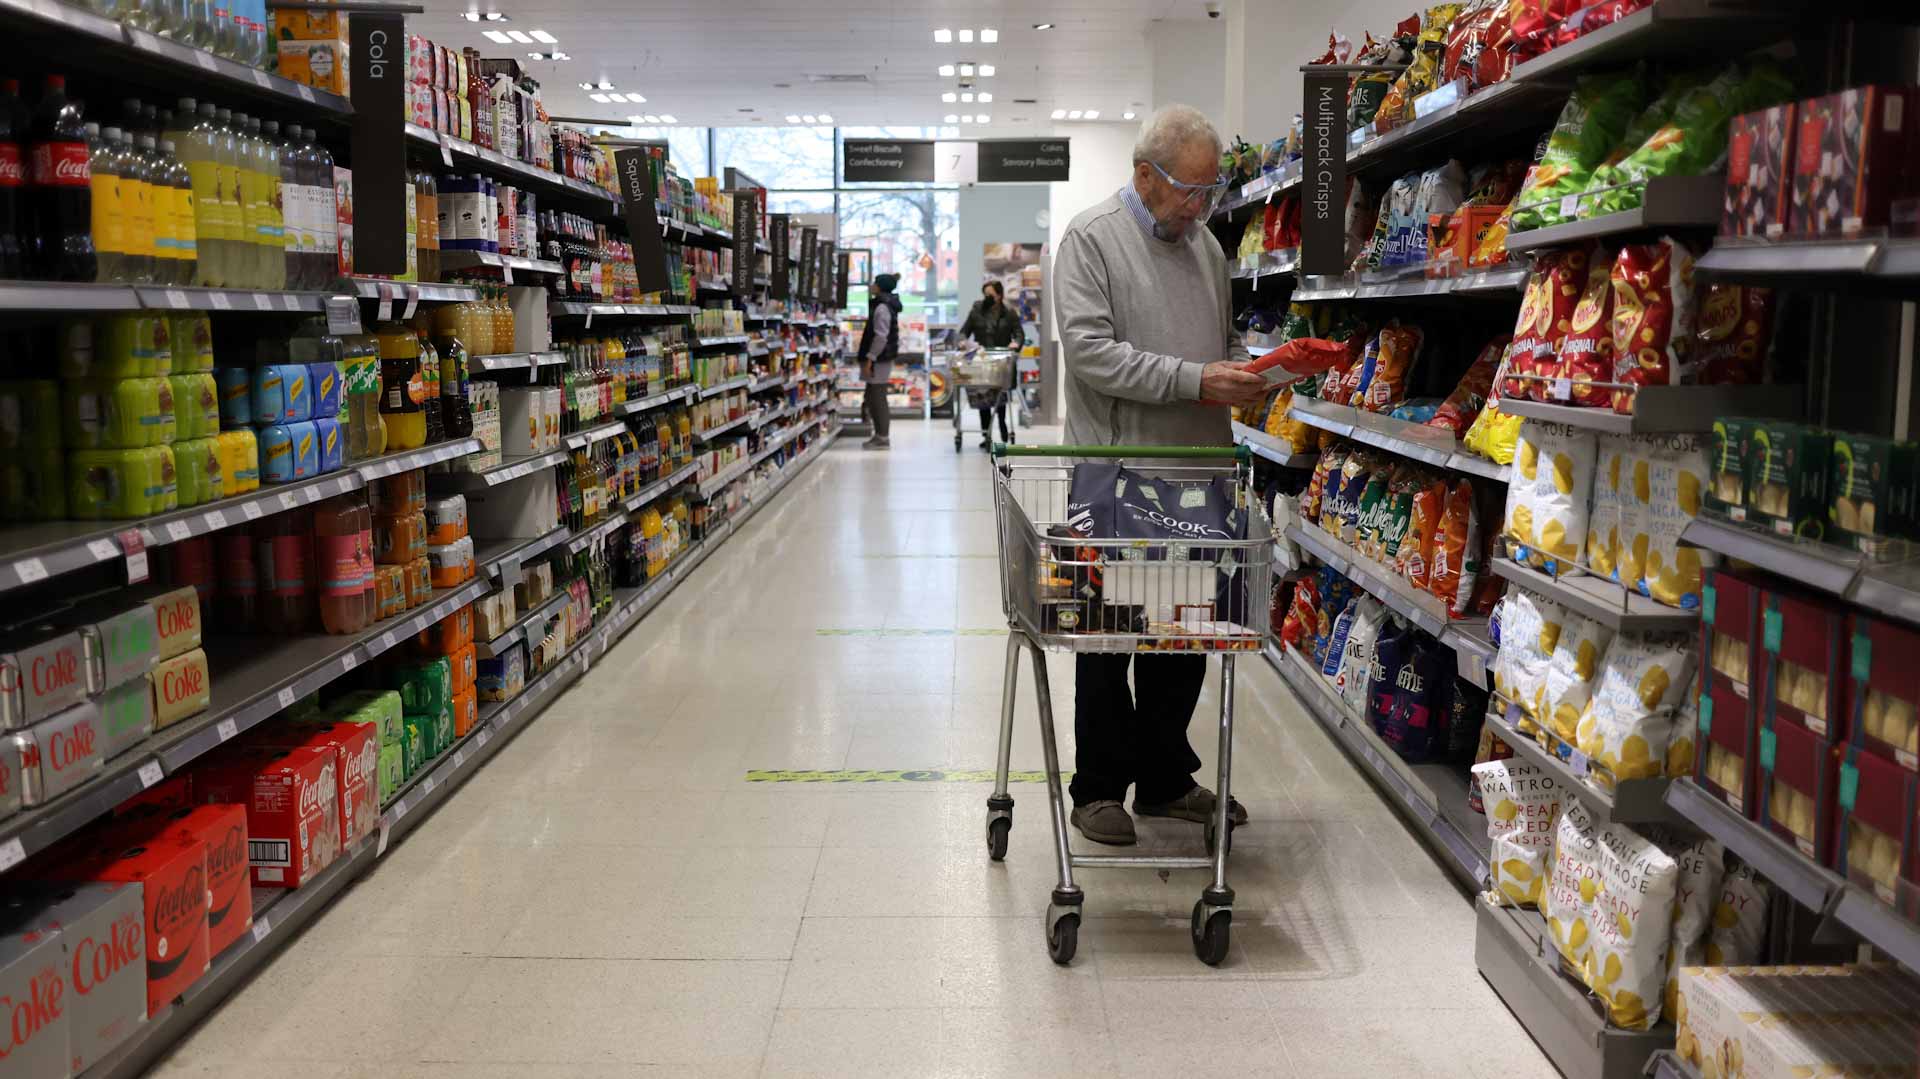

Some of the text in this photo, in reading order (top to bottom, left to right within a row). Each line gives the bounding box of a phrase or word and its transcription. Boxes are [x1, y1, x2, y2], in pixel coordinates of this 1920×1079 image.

[369, 30, 390, 78] Cola
[848, 158, 904, 169] Confectionery
[874, 145, 902, 154] Biscuits
[951, 154, 961, 171] 7
[1002, 158, 1065, 168] Savoury Biscuits
[1039, 143, 1065, 153] Cakes
[1312, 86, 1335, 219] Multipack Crisps
[625, 158, 645, 202] Squash
[738, 199, 749, 241] Multipack
[738, 269, 749, 289] Bars
[1147, 510, 1209, 536] COOK
[156, 601, 194, 639] Coke
[31, 649, 77, 697] Coke
[162, 666, 202, 705] Coke
[49, 721, 96, 772] Coke
[1481, 767, 1541, 779] SSENT
[1483, 776, 1556, 793] WAITRO
[1559, 853, 1602, 881] READY
[1600, 830, 1651, 876] SSENTIAL
[1551, 886, 1584, 917] RISPS
[1597, 891, 1640, 922] EADY
[71, 920, 142, 995] Coke
